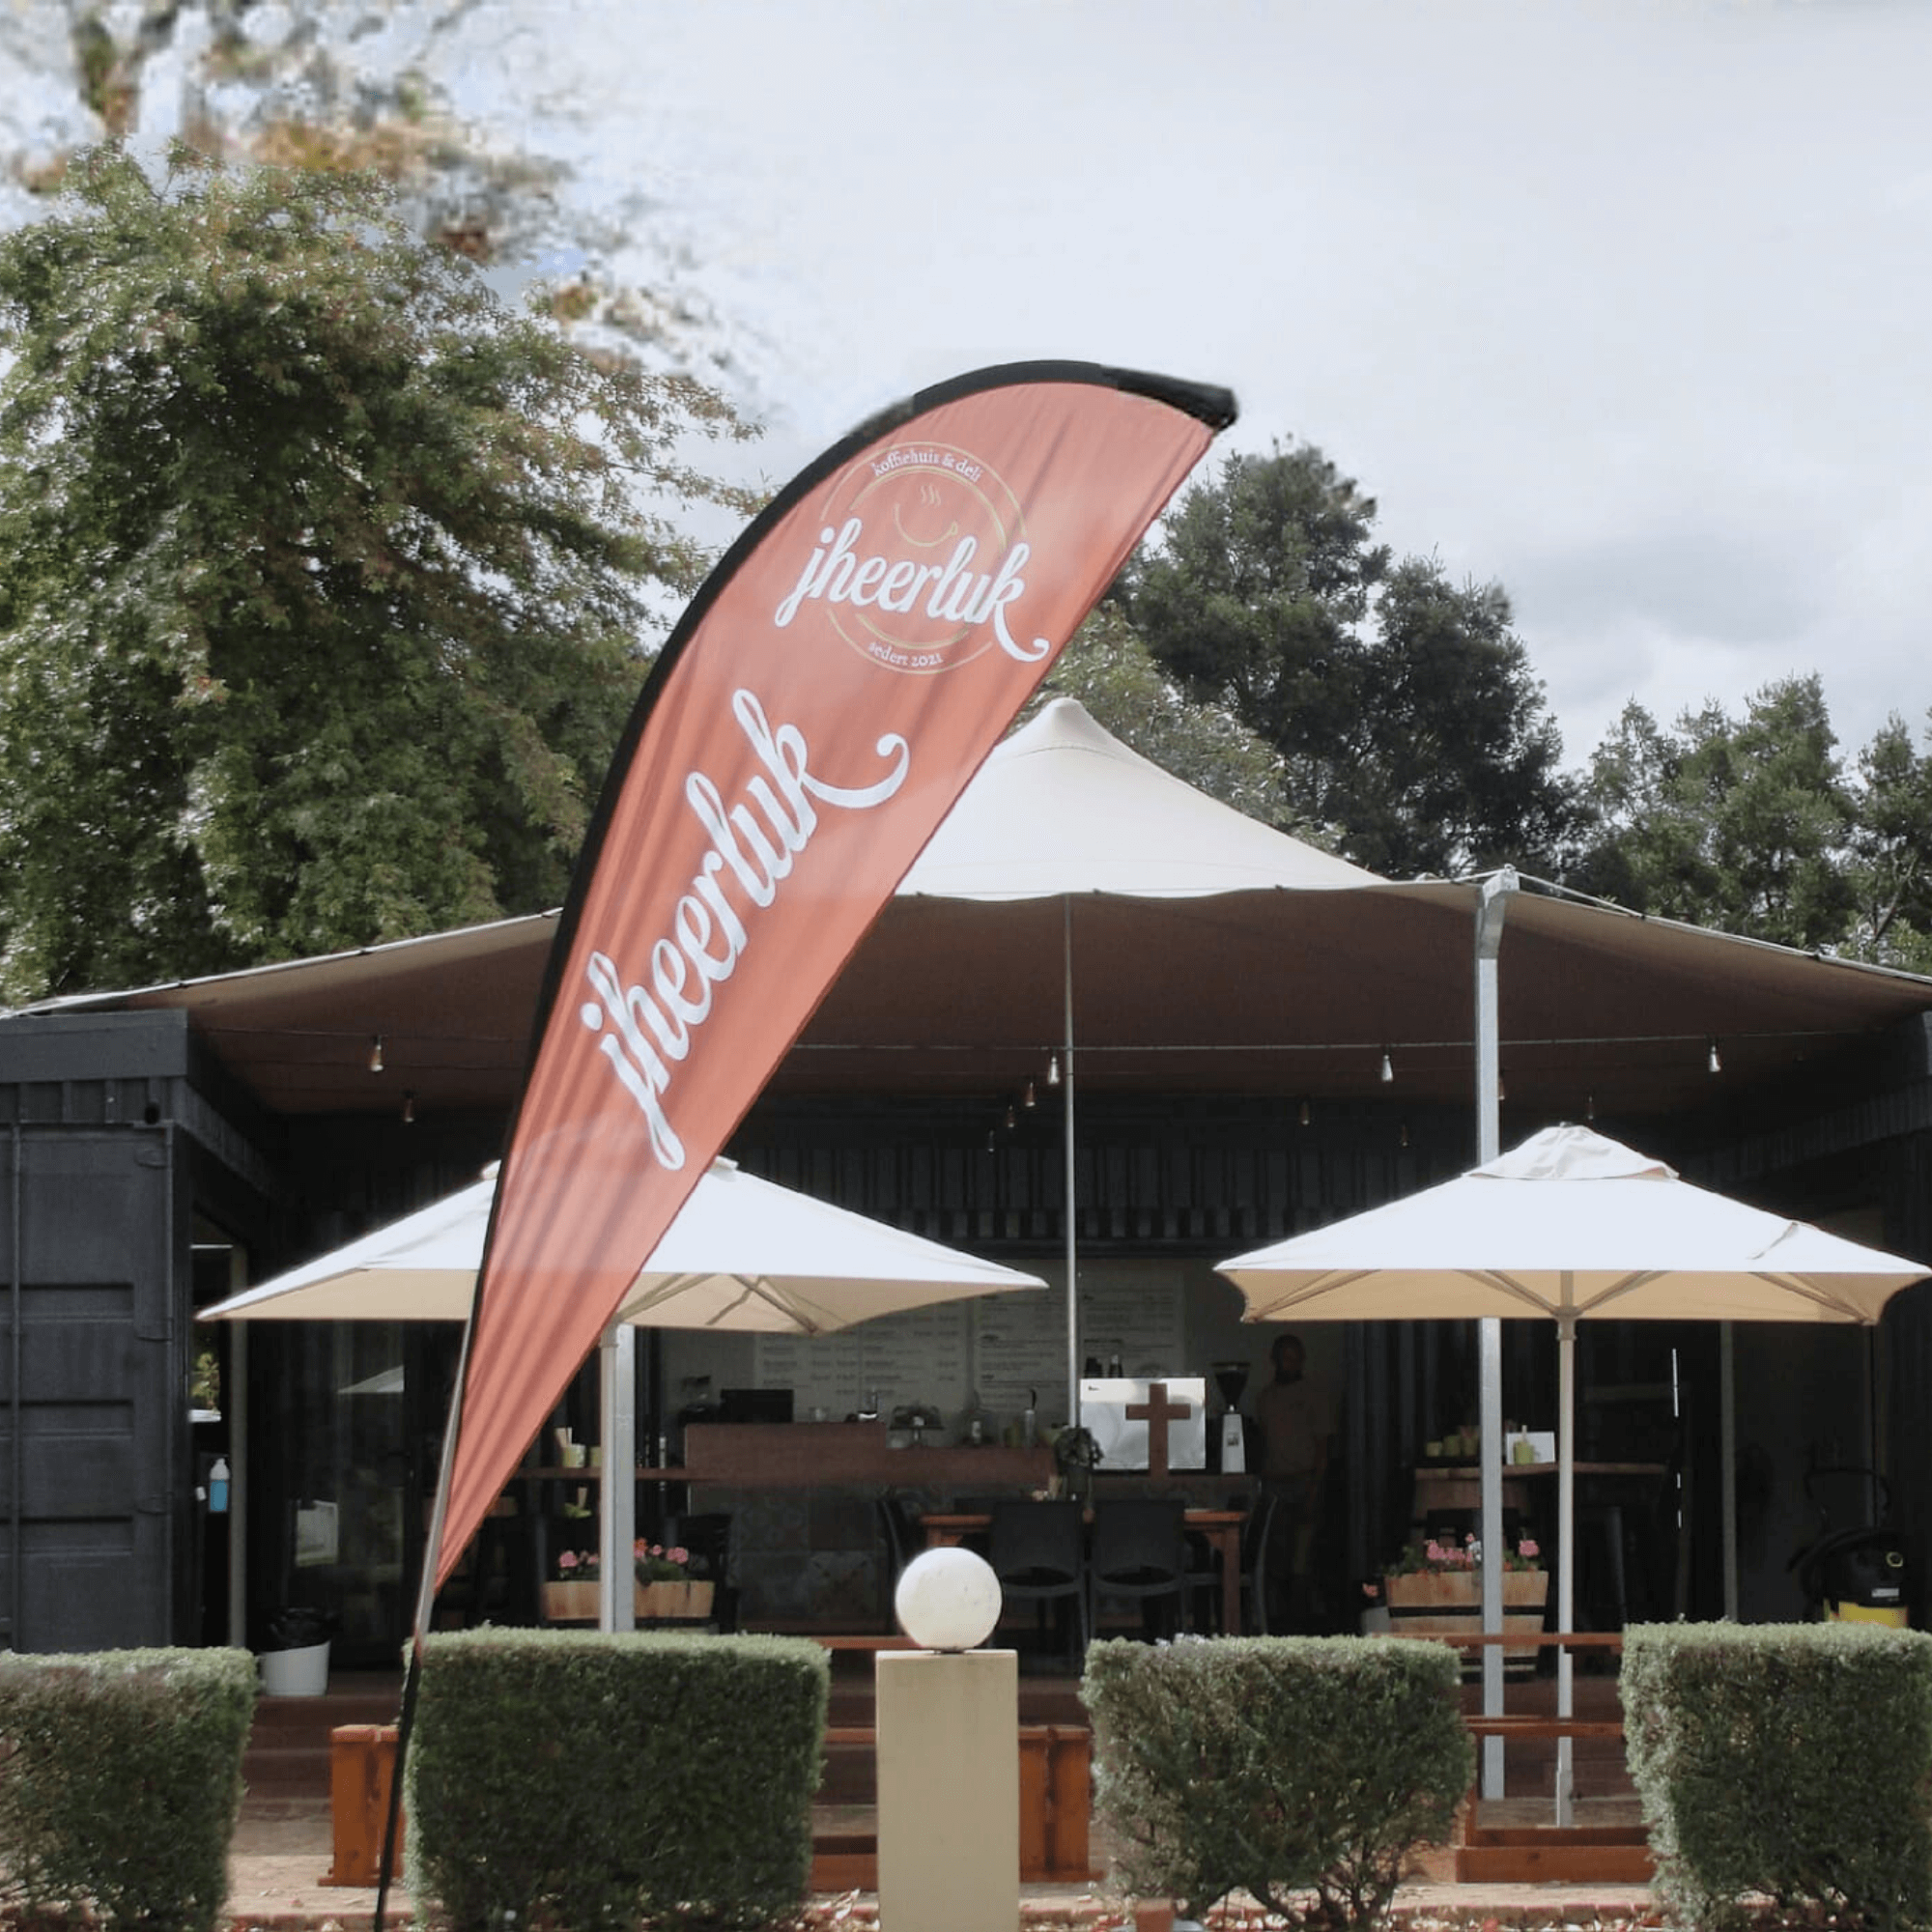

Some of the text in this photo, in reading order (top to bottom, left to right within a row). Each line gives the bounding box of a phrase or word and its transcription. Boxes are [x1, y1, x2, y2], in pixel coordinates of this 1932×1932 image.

[871, 447, 982, 483] koffiehuis & deli
[775, 517, 1050, 662] jheerluk
[868, 641, 944, 667] sedert 2021
[582, 689, 909, 1171] jheerluk
